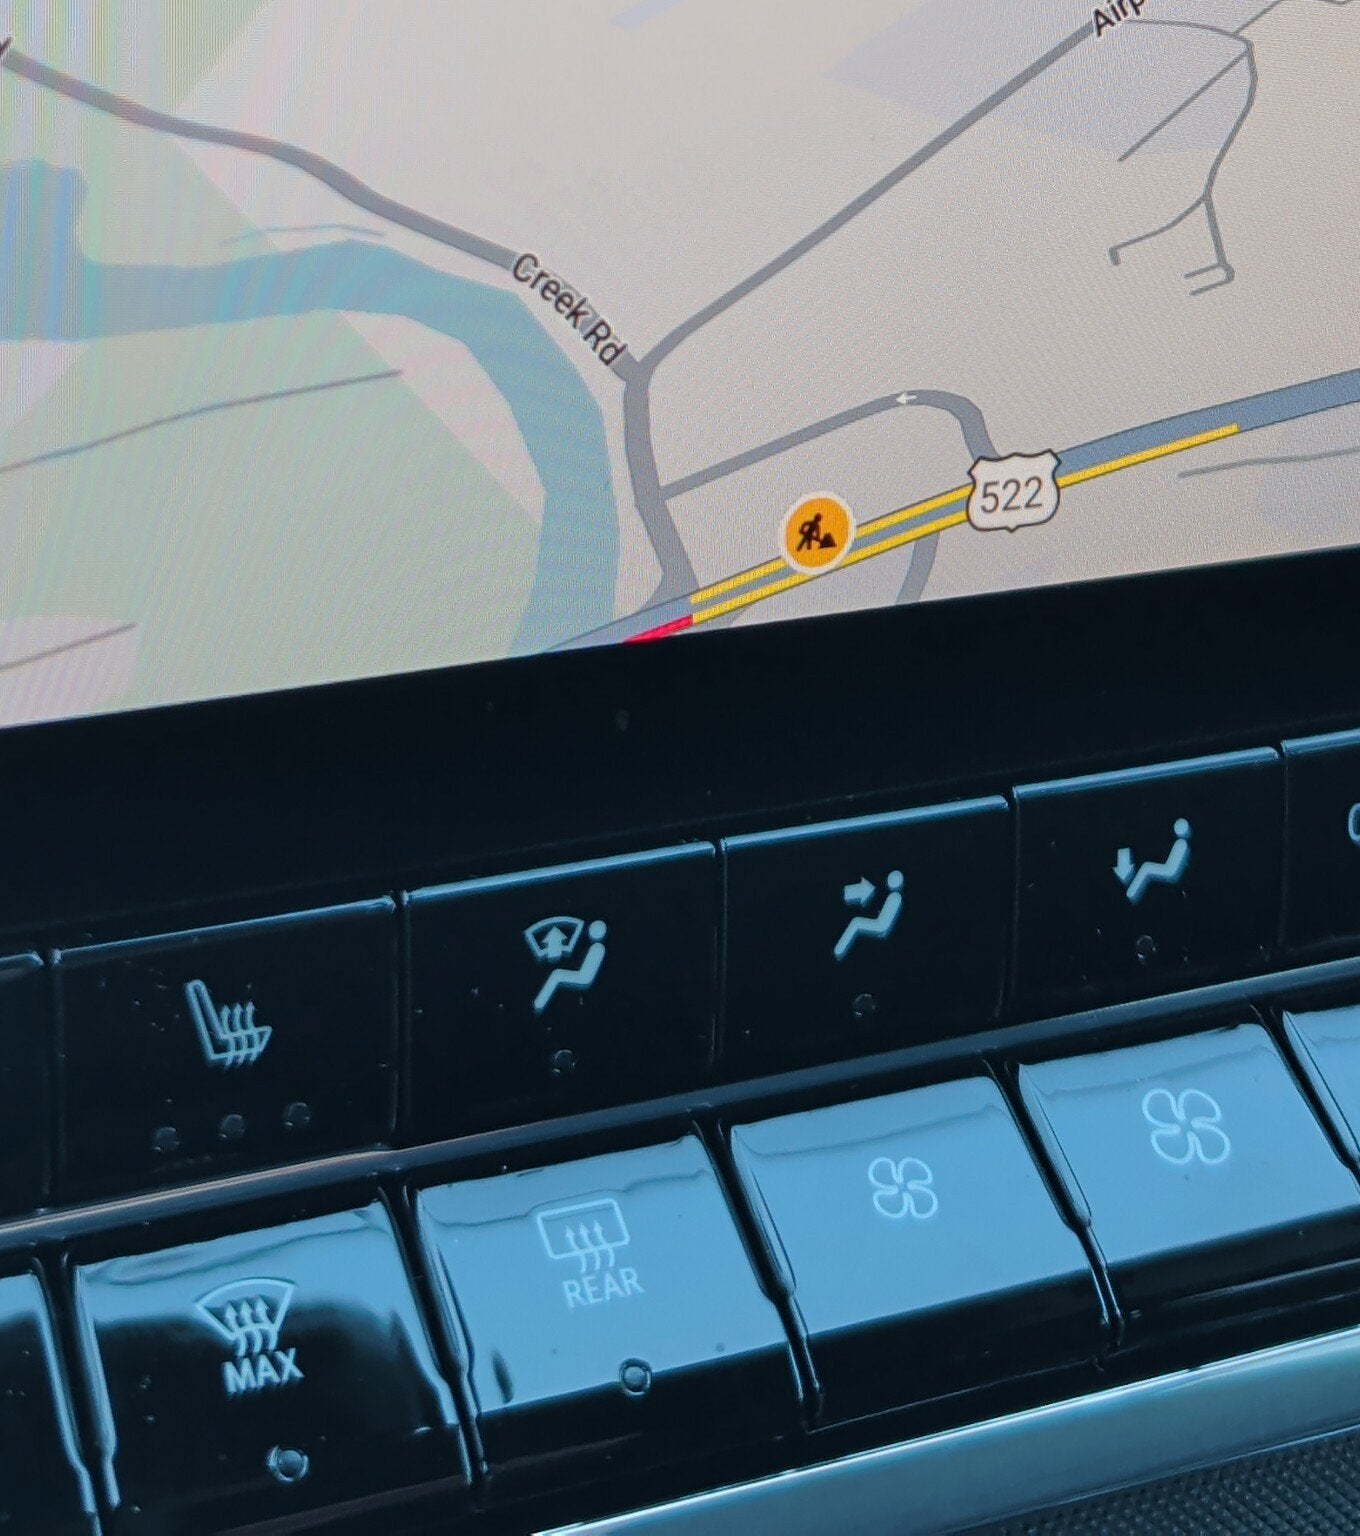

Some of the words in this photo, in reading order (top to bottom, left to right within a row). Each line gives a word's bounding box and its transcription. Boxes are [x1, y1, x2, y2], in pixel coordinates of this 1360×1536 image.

[513, 253, 590, 329] Creek
[583, 319, 627, 365] Rd
[980, 477, 1044, 513] 522
[562, 1267, 644, 1308] REAR
[222, 1348, 304, 1394] MAX
